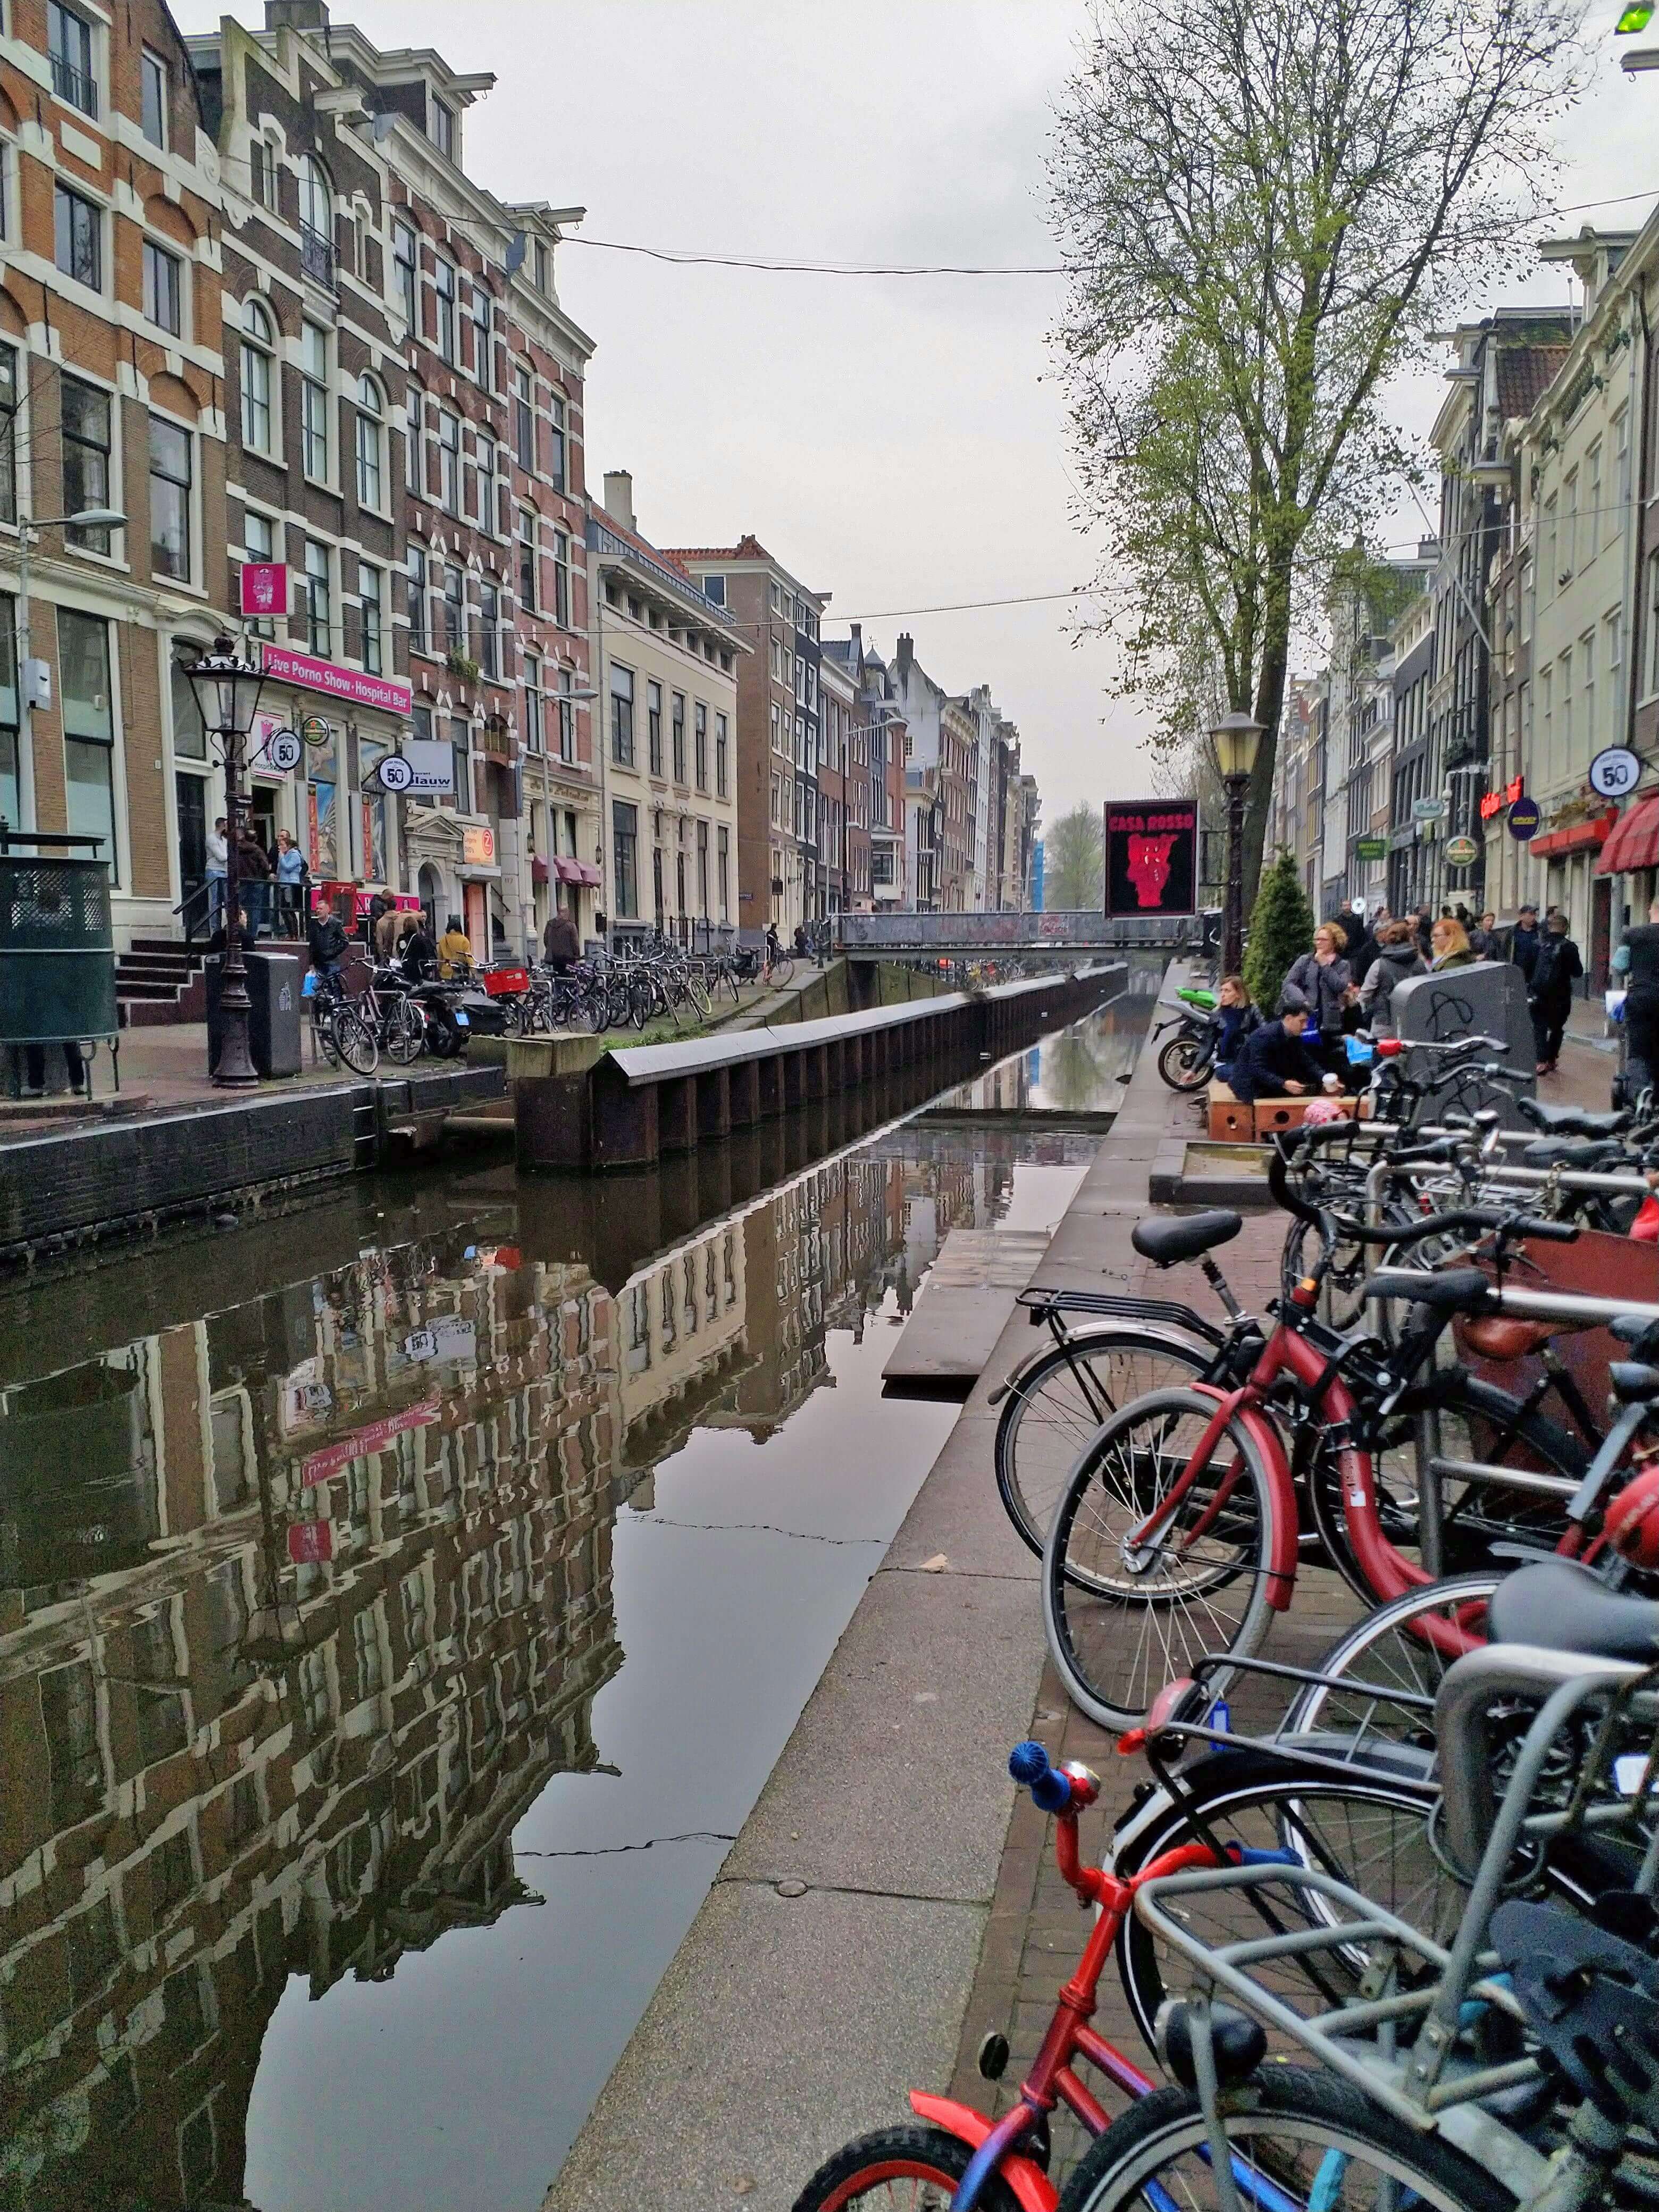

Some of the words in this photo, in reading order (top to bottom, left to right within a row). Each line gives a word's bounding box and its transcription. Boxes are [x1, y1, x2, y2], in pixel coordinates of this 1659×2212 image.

[267, 653, 290, 673] Live
[292, 661, 321, 683] Porno
[324, 671, 350, 691] Show
[356, 680, 391, 702] Hospital
[393, 692, 407, 708] Bar
[279, 745, 293, 761] 50
[387, 768, 404, 783] 50
[1603, 765, 1628, 787] 50
